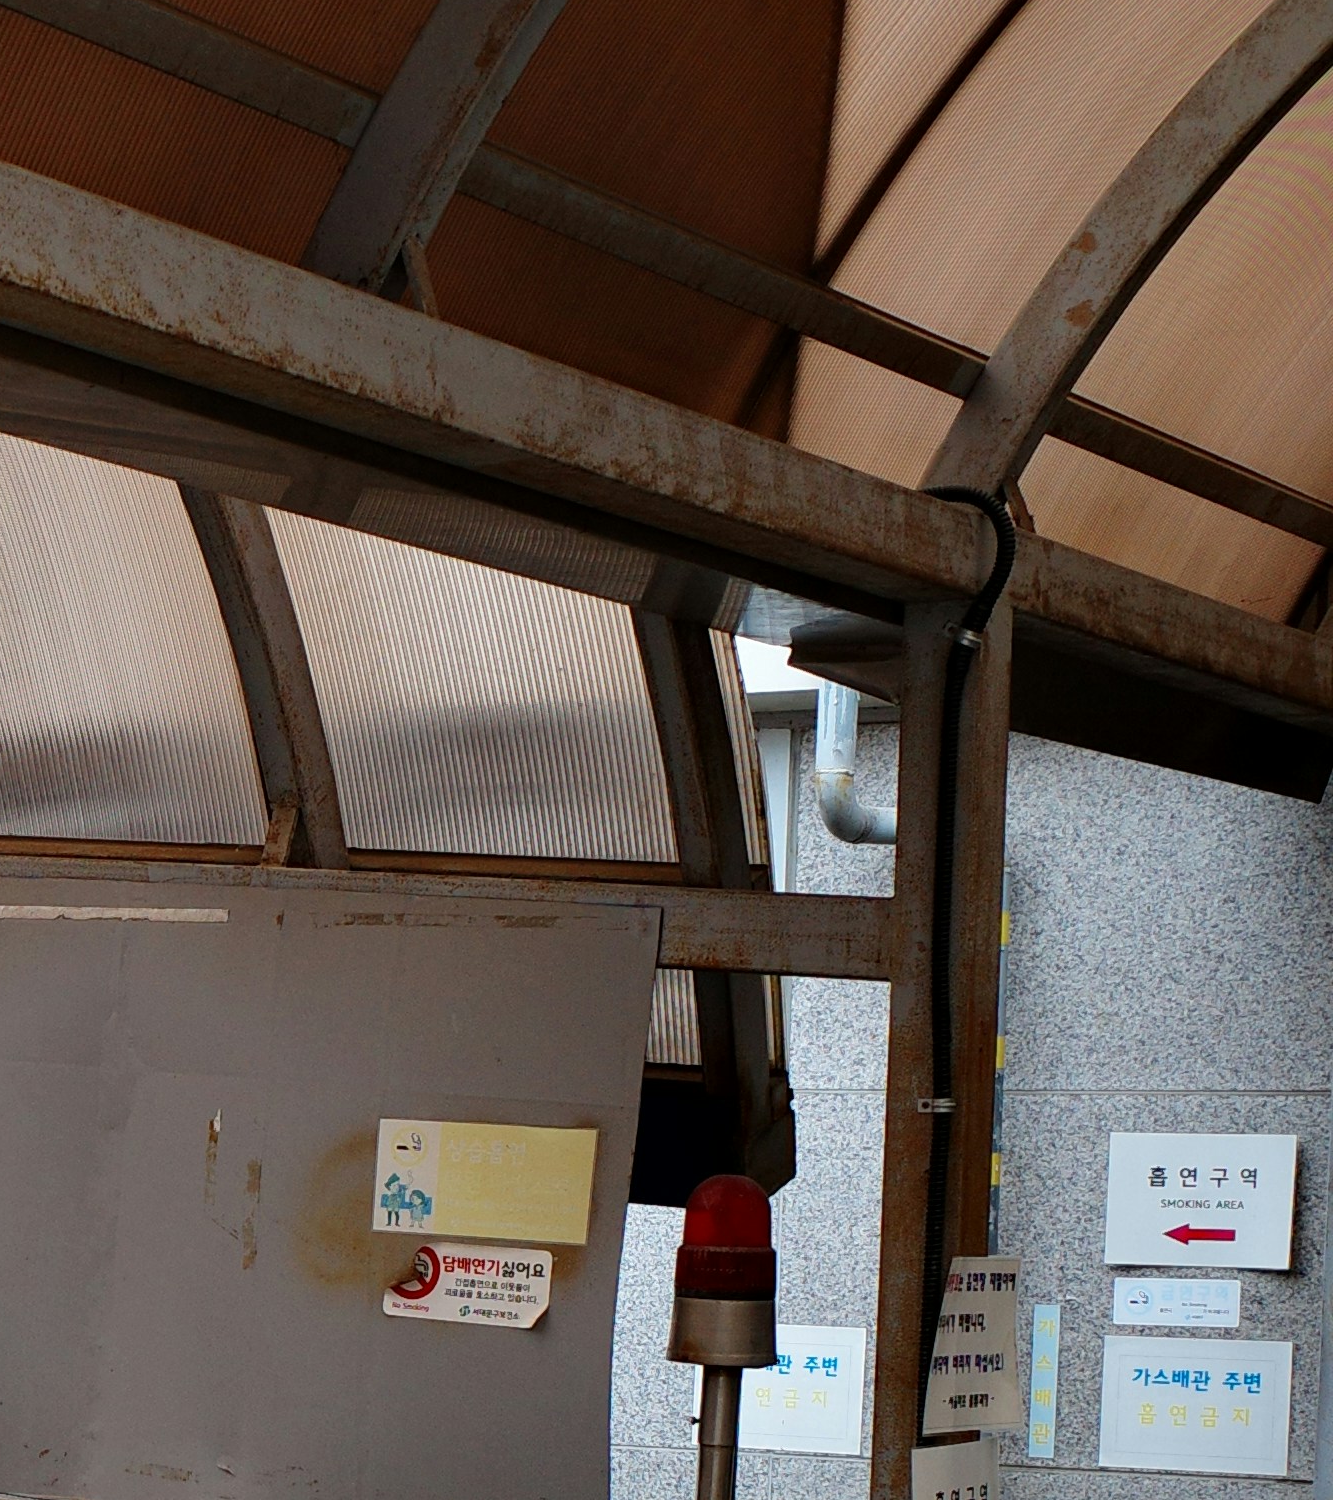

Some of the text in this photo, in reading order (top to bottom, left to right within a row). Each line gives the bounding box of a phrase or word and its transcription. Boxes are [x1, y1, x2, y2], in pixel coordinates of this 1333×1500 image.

[1147, 1166, 1258, 1189] 흡연구역
[1160, 1199, 1244, 1210] SMOKING AREA
[803, 1356, 838, 1377] 주변
[1032, 1319, 1055, 1444] 가스배관
[1131, 1368, 1262, 1394] 가스배관 주변
[755, 1388, 827, 1409] 연금지
[1138, 1403, 1250, 1428] 흡연금지
